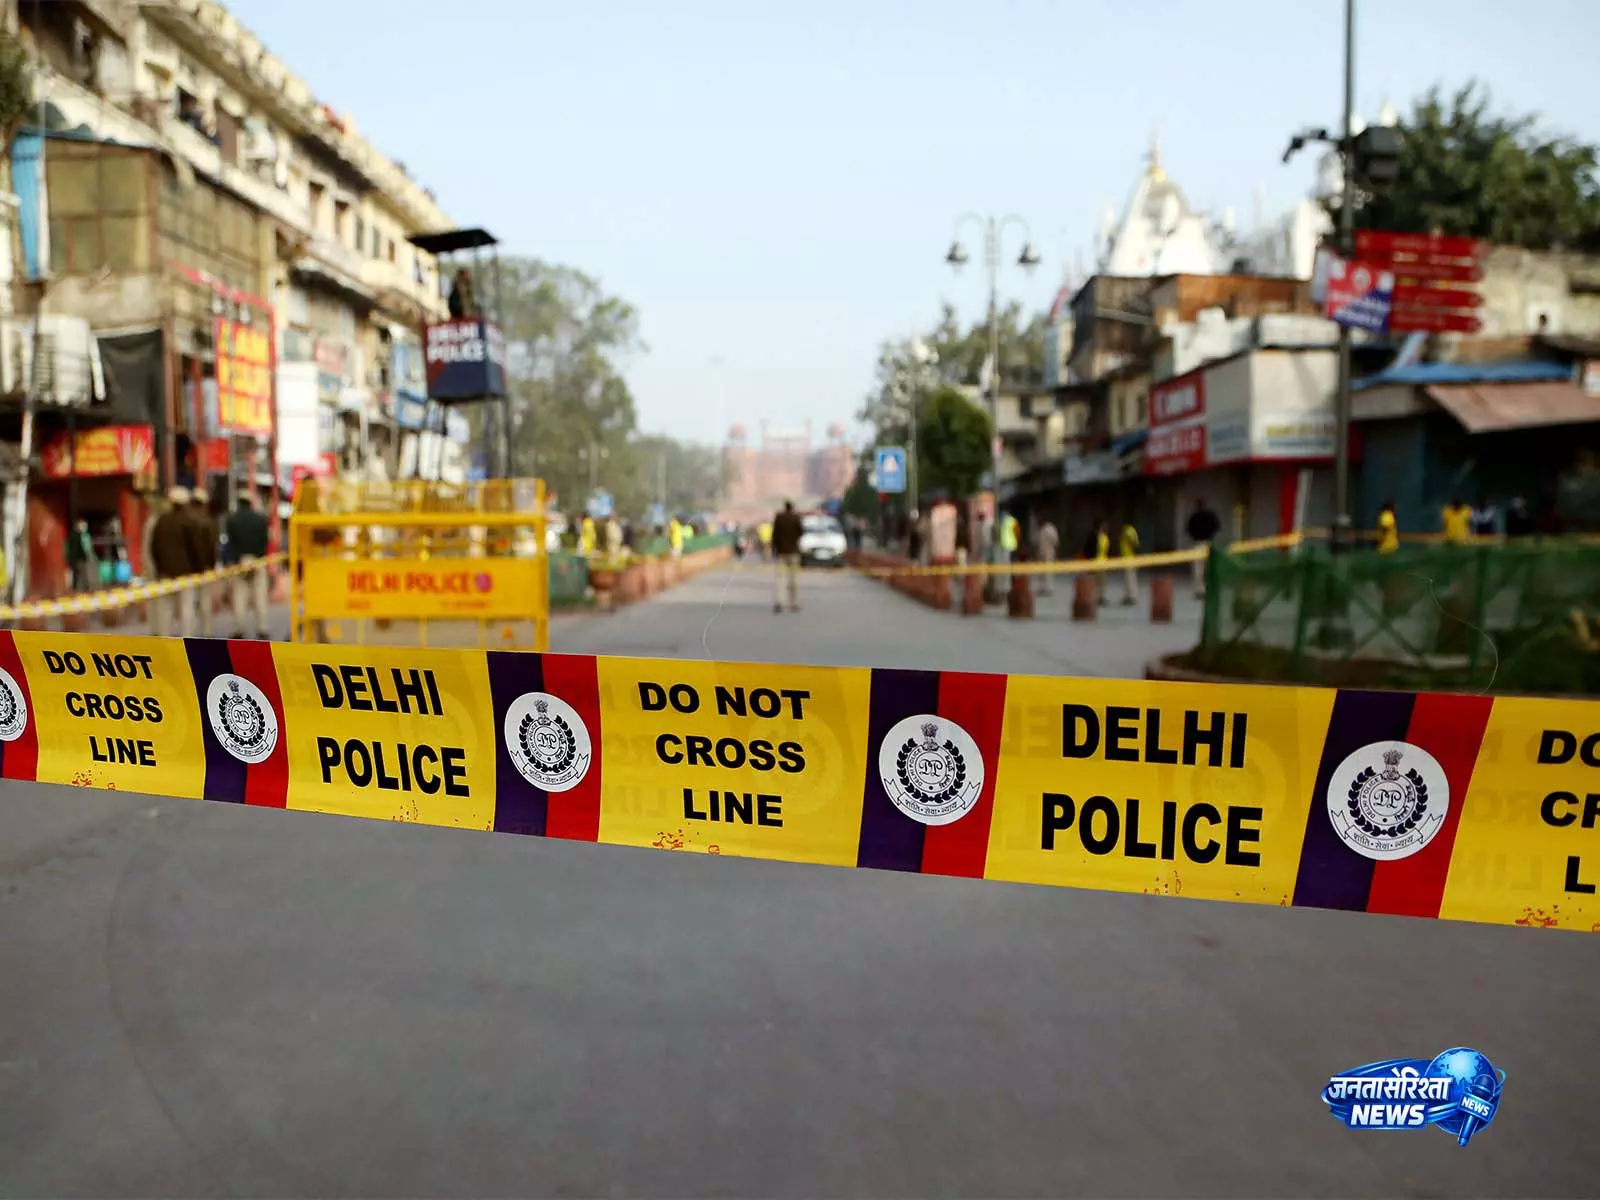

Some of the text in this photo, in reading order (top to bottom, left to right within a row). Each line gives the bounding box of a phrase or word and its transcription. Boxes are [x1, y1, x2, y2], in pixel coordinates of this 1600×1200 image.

[347, 571, 469, 593] DELHI POLICE
[42, 650, 153, 680] DO NOT
[65, 691, 163, 723] CROSS
[310, 663, 444, 716] DELHI
[637, 682, 811, 720] DO NOT
[89, 735, 157, 767] LINE
[655, 733, 806, 773] CROSS
[1062, 703, 1248, 769] DELHI
[316, 736, 470, 798] POLICE
[683, 788, 783, 828] LINE
[1041, 792, 1263, 867] POLICE
